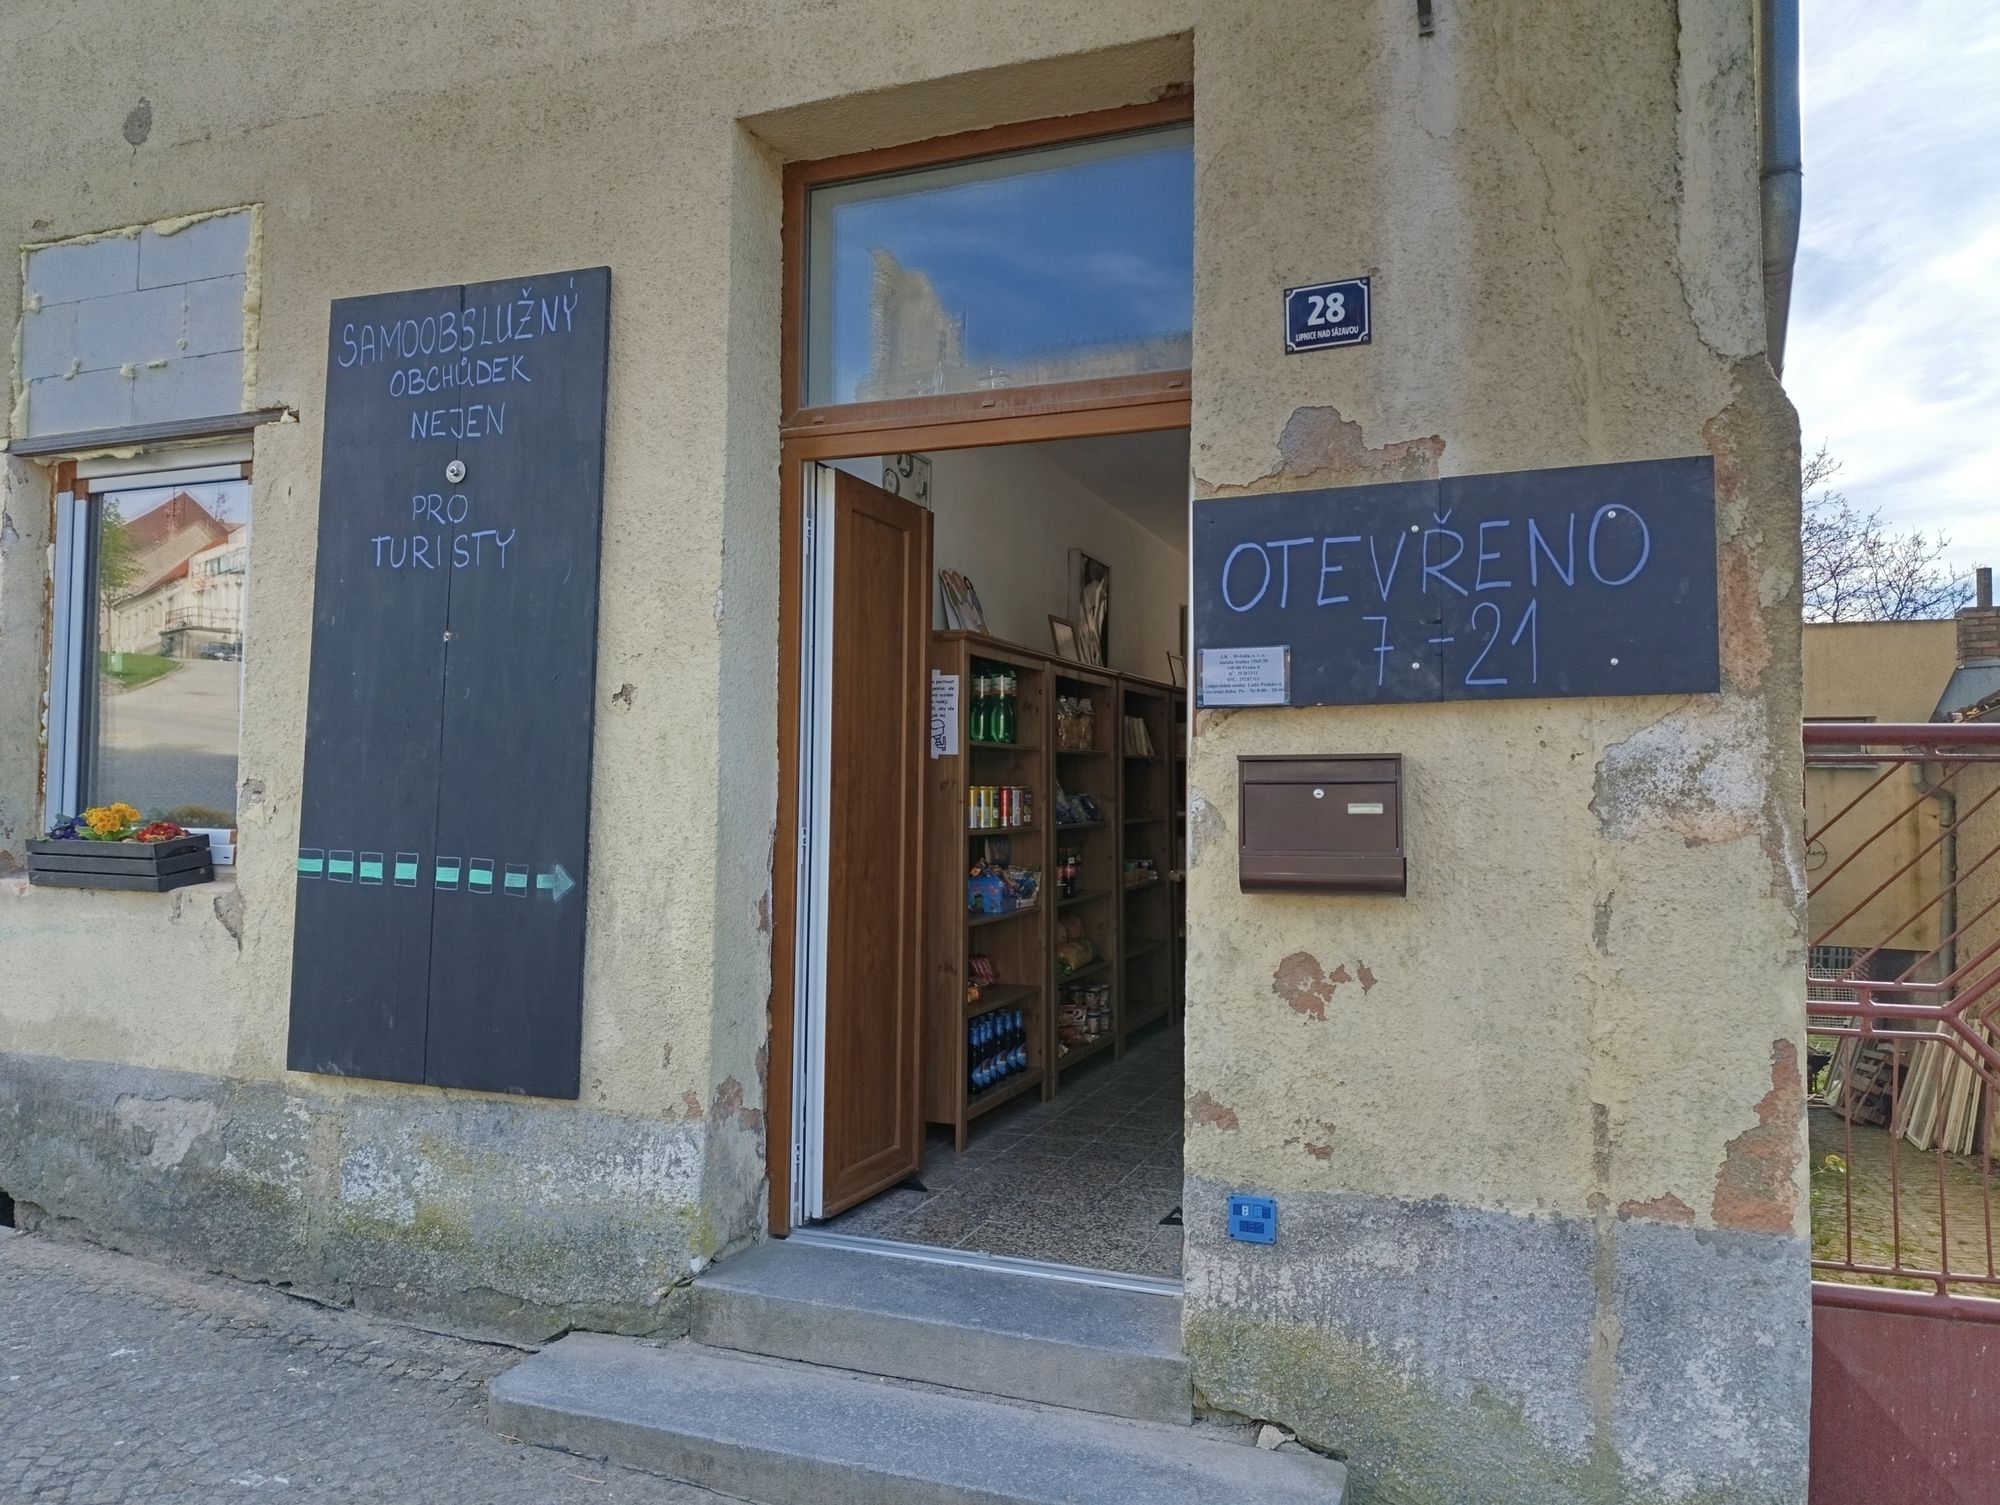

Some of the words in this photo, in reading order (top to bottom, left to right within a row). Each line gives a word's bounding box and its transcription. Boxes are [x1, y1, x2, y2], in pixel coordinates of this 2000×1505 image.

[338, 277, 577, 367] SAMOOBSLUŽNÝ
[1307, 292, 1345, 326] 28
[1295, 330, 1317, 342] LIPNICE
[1317, 328, 1331, 339] NAD
[1331, 325, 1359, 337] SÁZAVOU
[389, 355, 531, 397] OBCHŮDEK
[411, 402, 506, 439] NEJEN
[412, 494, 468, 524] PRO
[371, 528, 515, 569] TURISTY
[1222, 503, 1650, 612] OTEVŘENO
[1465, 598, 1538, 686] 21
